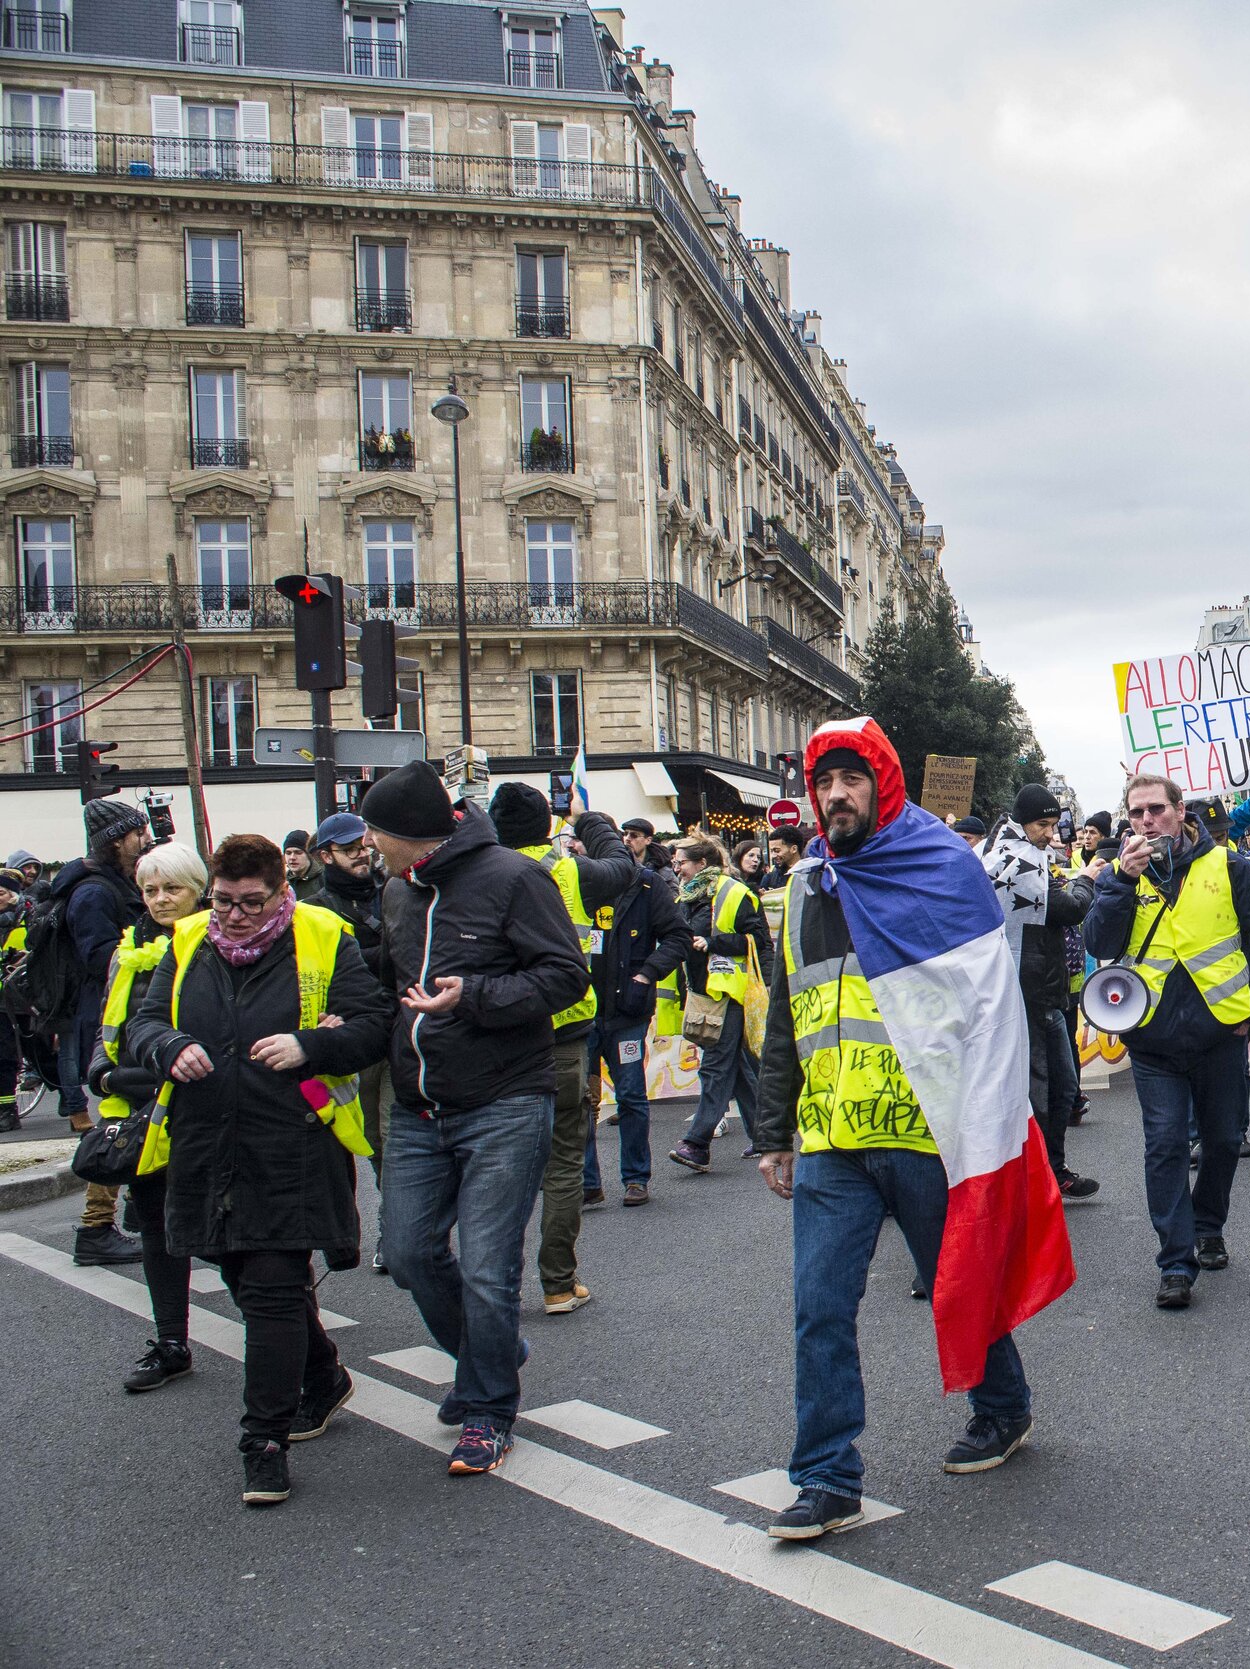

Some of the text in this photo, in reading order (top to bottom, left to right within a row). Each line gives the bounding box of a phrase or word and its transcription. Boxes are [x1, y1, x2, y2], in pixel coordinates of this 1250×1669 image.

[1124, 655, 1197, 713] ALLO
[1125, 706, 1183, 753] LE
[943, 794, 969, 803] AVANCE
[850, 1046, 875, 1072] LE
